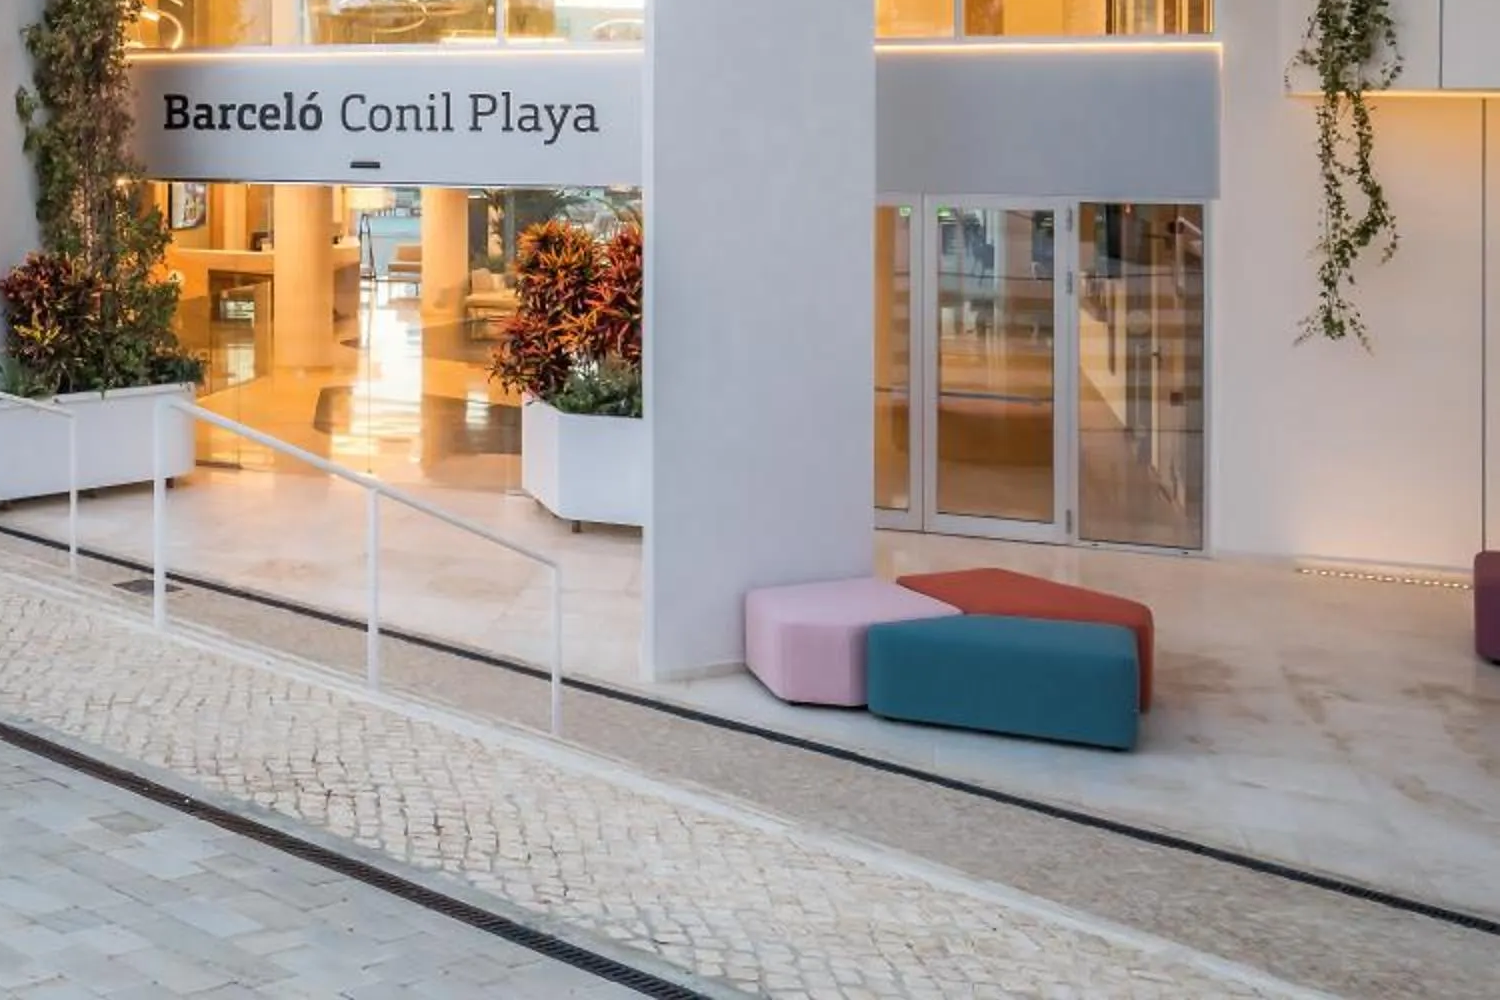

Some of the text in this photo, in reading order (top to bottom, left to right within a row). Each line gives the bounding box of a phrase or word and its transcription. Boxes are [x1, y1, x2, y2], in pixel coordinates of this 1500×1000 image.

[163, 91, 600, 145] Barceló Conil Playa
